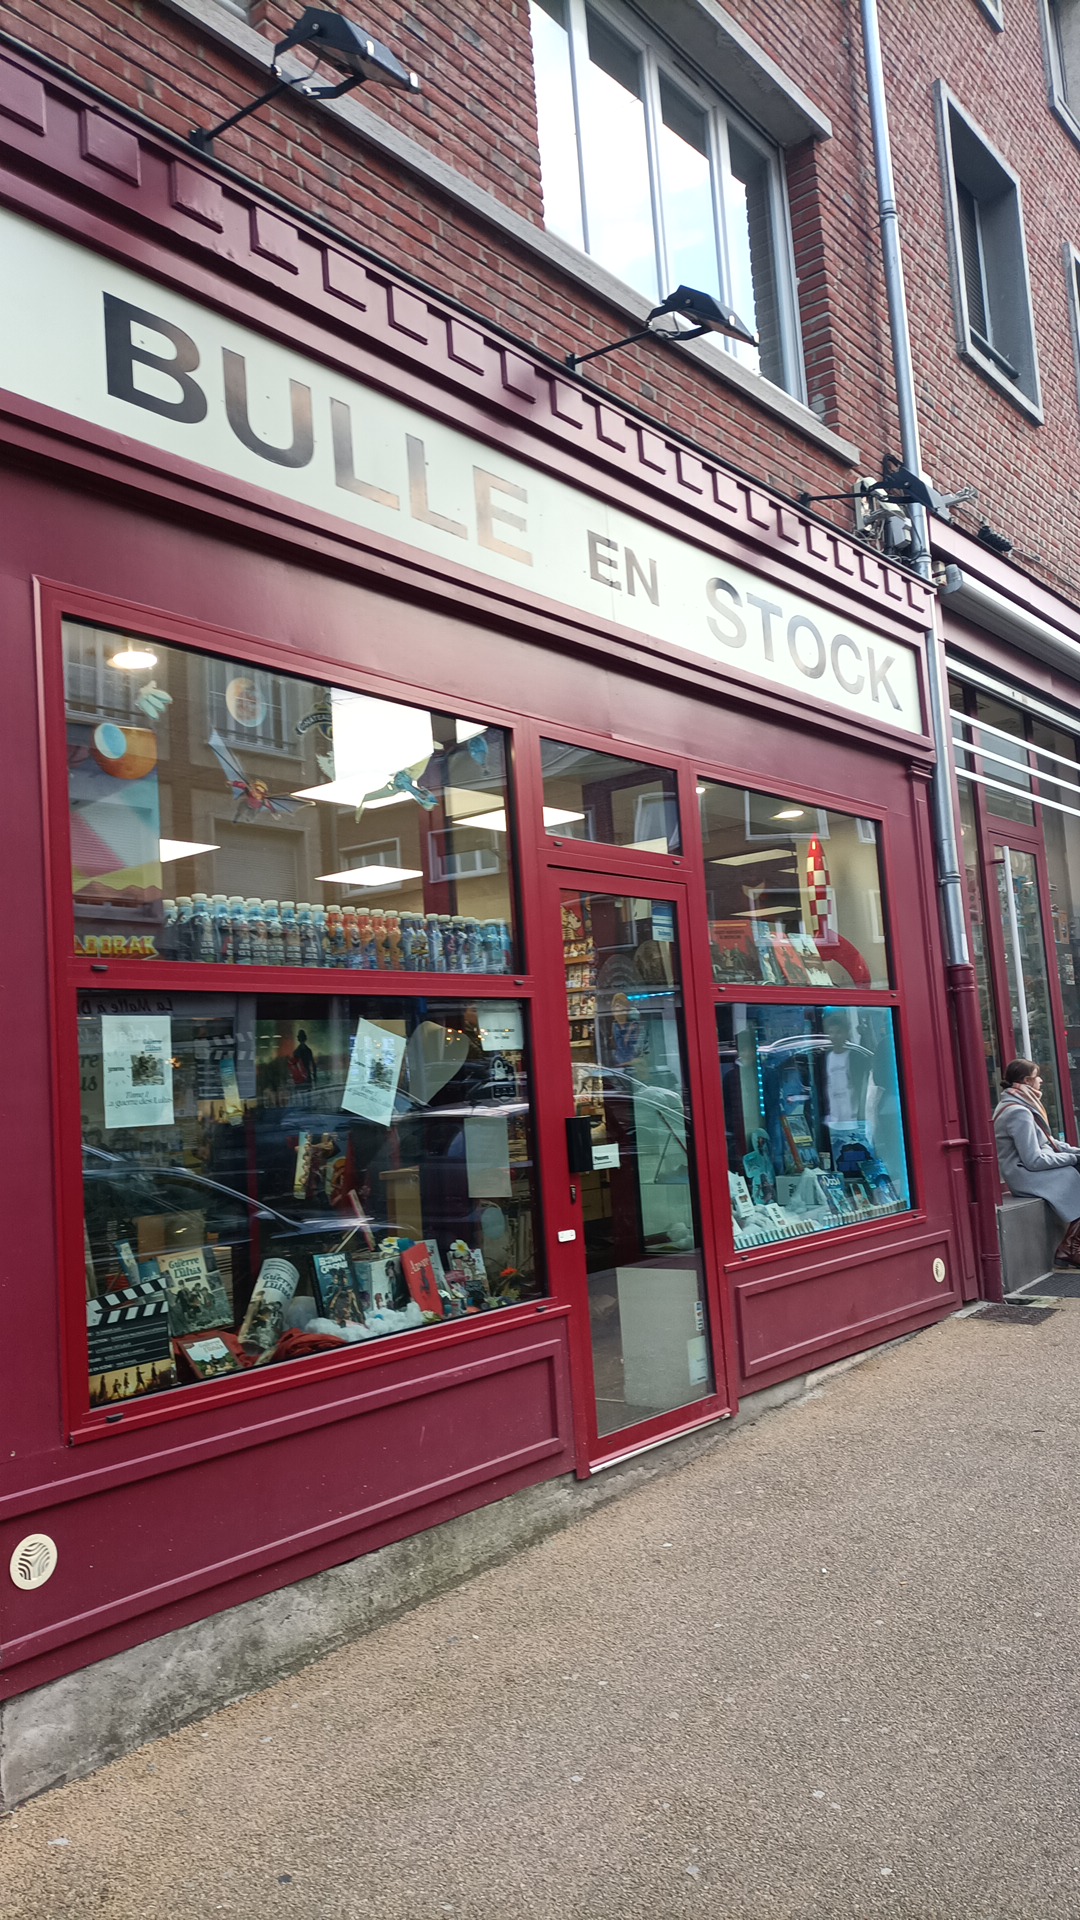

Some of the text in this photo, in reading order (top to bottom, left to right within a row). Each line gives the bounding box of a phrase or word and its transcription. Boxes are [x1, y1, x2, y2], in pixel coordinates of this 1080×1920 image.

[103, 291, 904, 712] BULLE EN STOCK
[168, 1257, 200, 1270] Guerre
[262, 1271, 294, 1291] Guerre
